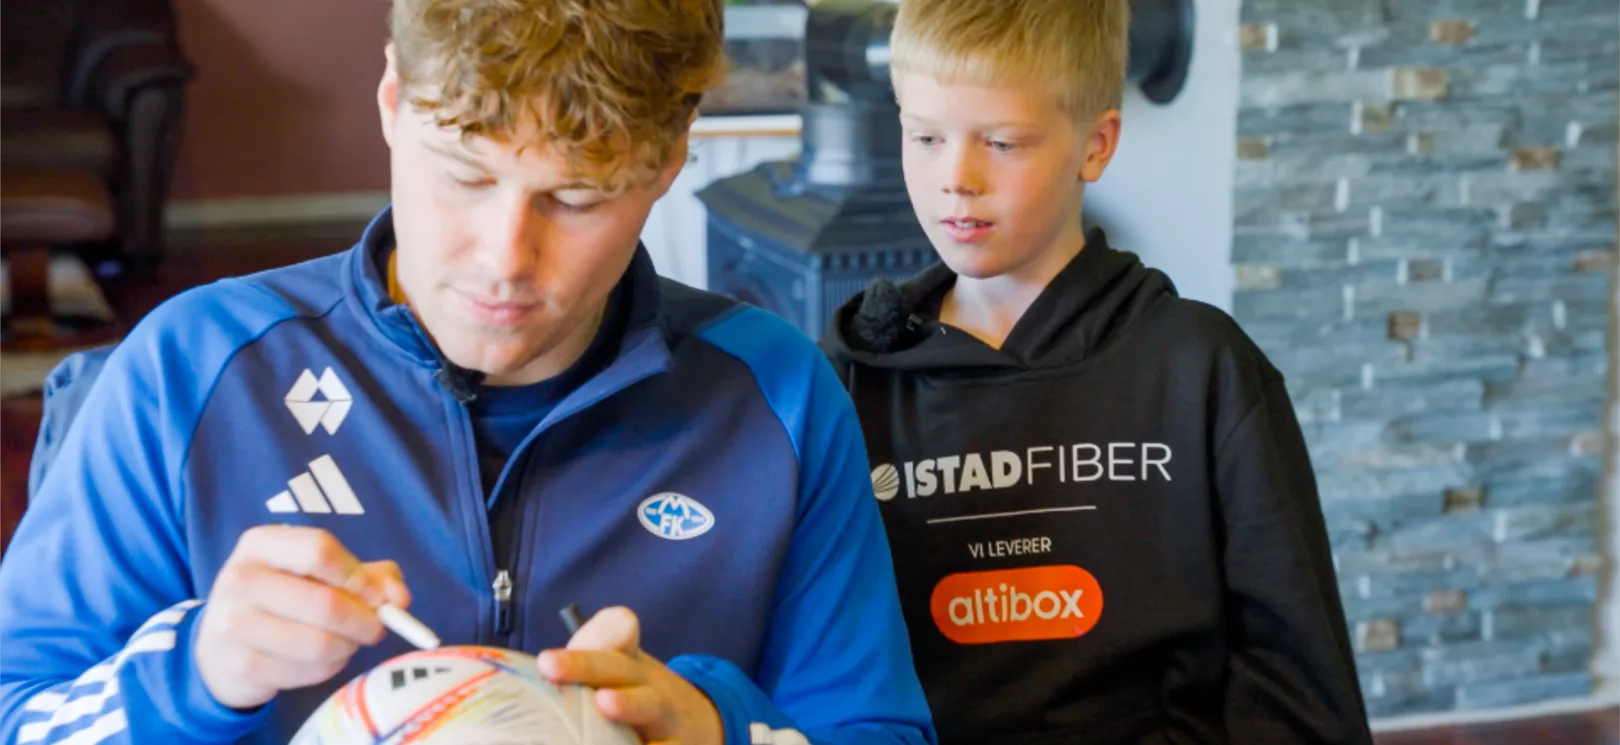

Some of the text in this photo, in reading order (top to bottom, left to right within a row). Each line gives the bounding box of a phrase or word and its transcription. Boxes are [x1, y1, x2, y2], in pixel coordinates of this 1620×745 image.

[968, 537, 1052, 559] VI LEVERER
[948, 583, 1084, 627] altibox
